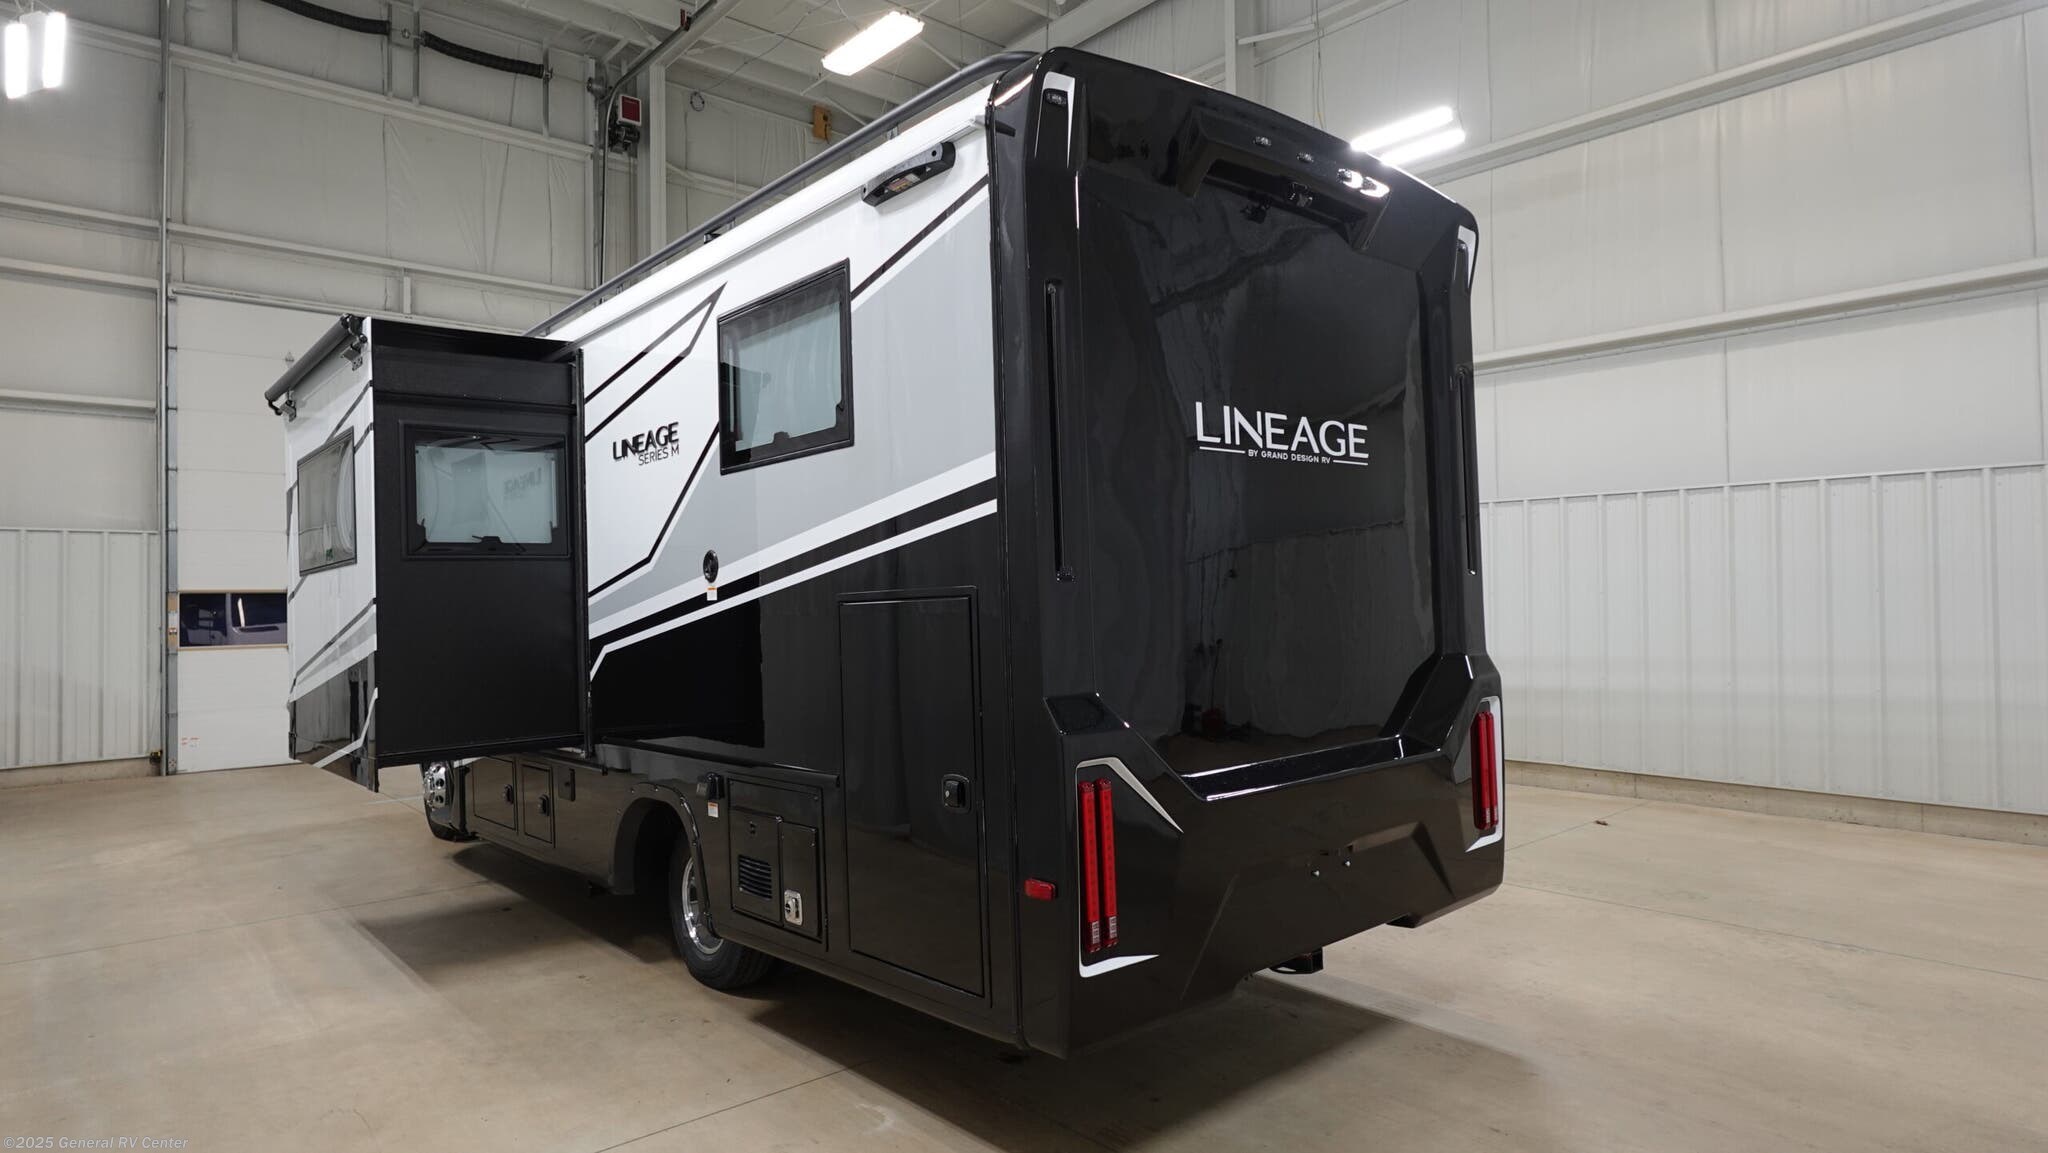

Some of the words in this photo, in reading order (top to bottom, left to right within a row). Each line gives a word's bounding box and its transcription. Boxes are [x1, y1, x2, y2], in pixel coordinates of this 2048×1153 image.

[612, 421, 679, 461] LINEAGE
[1195, 401, 1369, 459] LINEAGE
[639, 447, 669, 466] SERIES
[671, 443, 679, 457] M
[1248, 449, 1259, 457] BY
[1261, 451, 1289, 461] GRAND
[1291, 453, 1320, 464] DESIGN
[1321, 456, 1331, 464] RV
